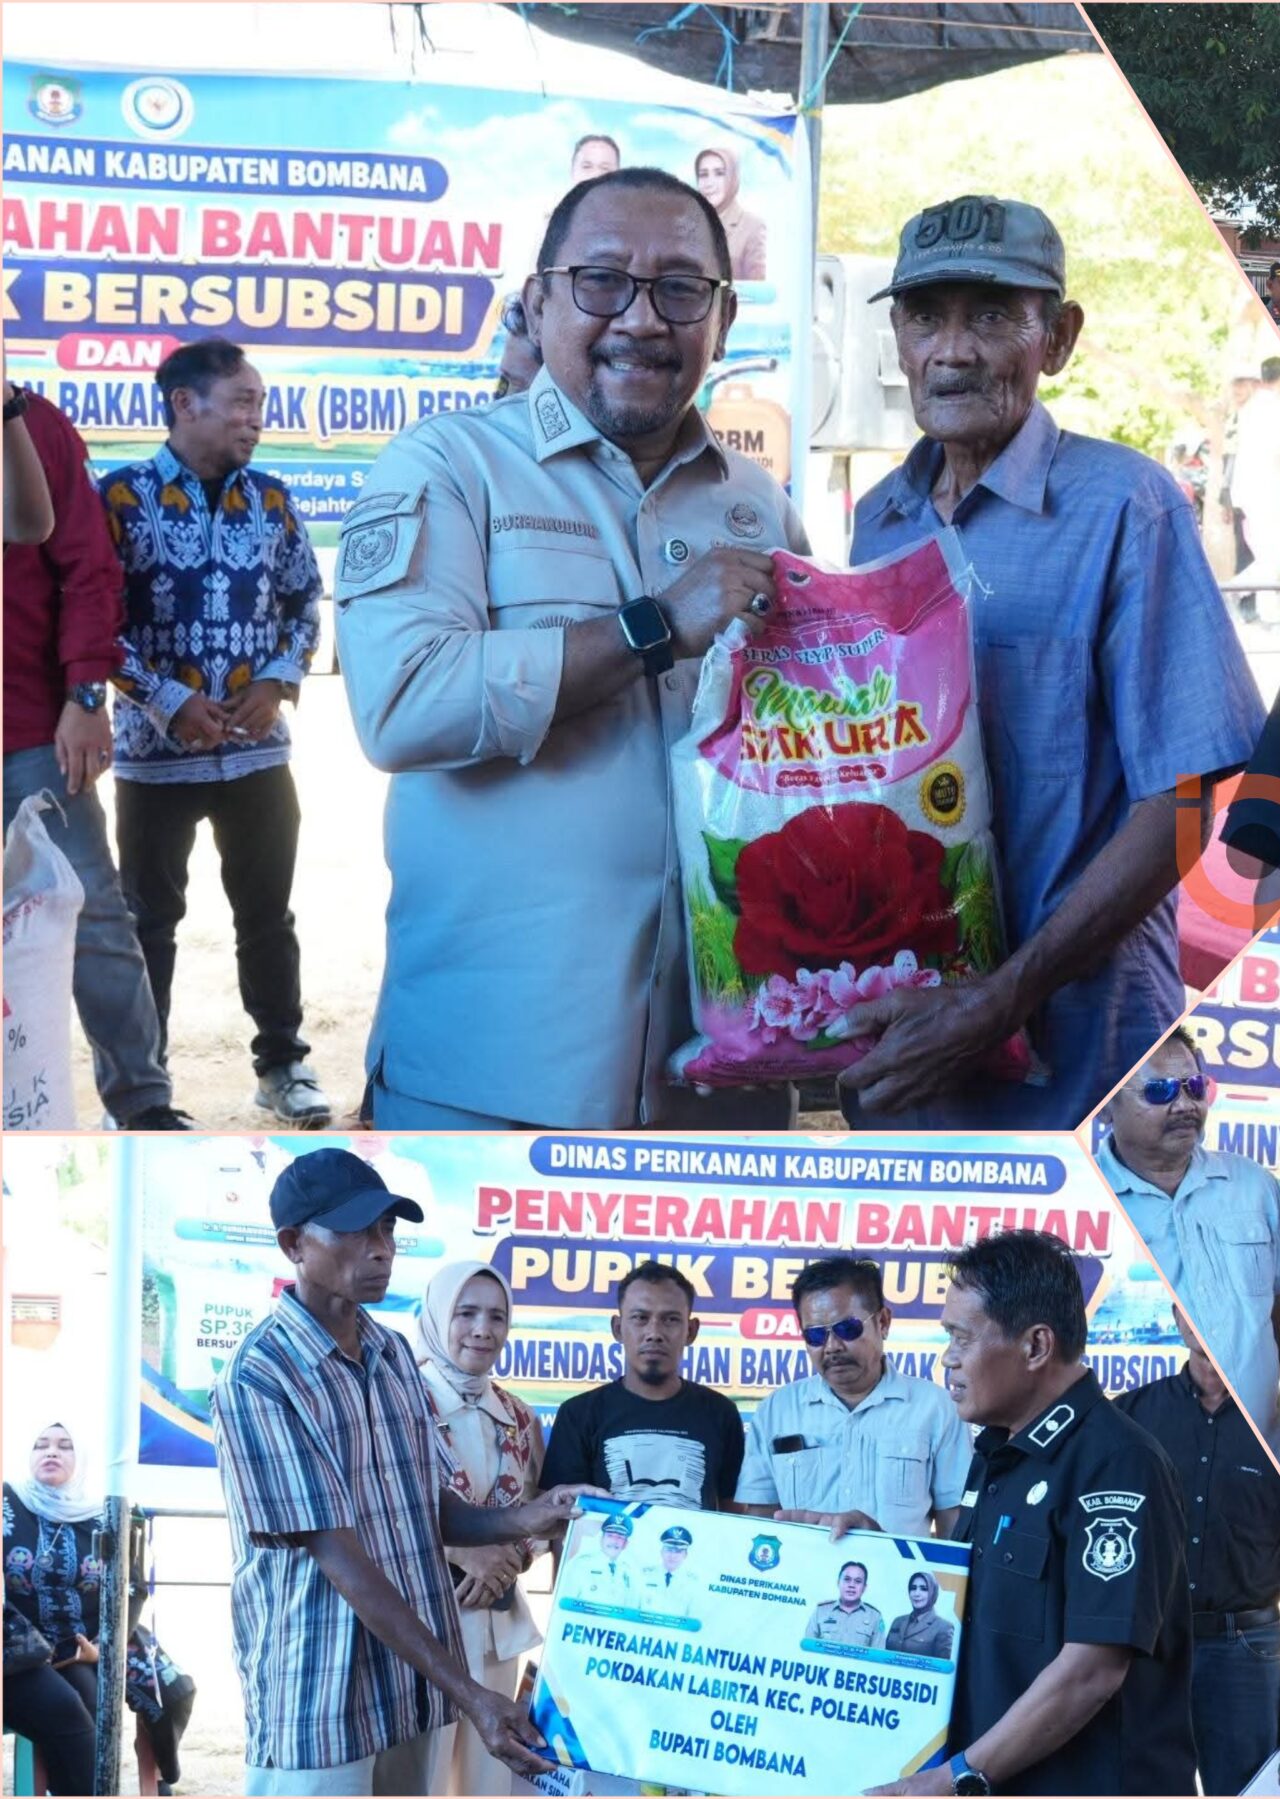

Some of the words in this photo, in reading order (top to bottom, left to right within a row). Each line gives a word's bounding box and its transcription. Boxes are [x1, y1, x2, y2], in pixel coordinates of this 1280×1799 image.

[104, 150, 279, 185] KABUPATEN
[287, 159, 427, 193] BOMBANA
[201, 209, 503, 269] BANTUAN
[914, 194, 1007, 249] 501
[43, 270, 464, 335] BERSUBSIDI
[75, 338, 163, 368] DAN
[318, 384, 407, 438] (BBM)
[837, 629, 886, 657] SUPER
[8, 1023, 27, 1051] %
[550, 1143, 627, 1171] DINAS
[634, 1147, 777, 1178] PERIKANAN
[784, 1154, 924, 1183] KABUPATEN
[934, 1159, 1048, 1187] BOMBANA
[476, 1186, 842, 1245] PENYERAHAN
[511, 1246, 715, 1298] PUPK
[204, 1303, 253, 1319] PUPUK
[1104, 1495, 1138, 1507] BOMBANA
[708, 1584, 761, 1600] KABUPATEN
[761, 1591, 807, 1606] BOMBANA
[720, 1573, 748, 1586] DINAS
[749, 1578, 800, 1594] PERIKANAN
[562, 1622, 678, 1661] PENYERAHAN
[681, 1644, 767, 1676] BANTUAN
[770, 1658, 830, 1687] PUPUK
[833, 1669, 939, 1706] BERSUBSIDI
[585, 1656, 685, 1693] POKDAKAN
[687, 1673, 759, 1707] LABIRTA
[764, 1688, 805, 1714] KEC.
[810, 1696, 901, 1731] POLEANG
[710, 1709, 758, 1737] OLEH
[649, 1729, 709, 1760] BUPATI
[713, 1740, 808, 1778] BOMBANA
